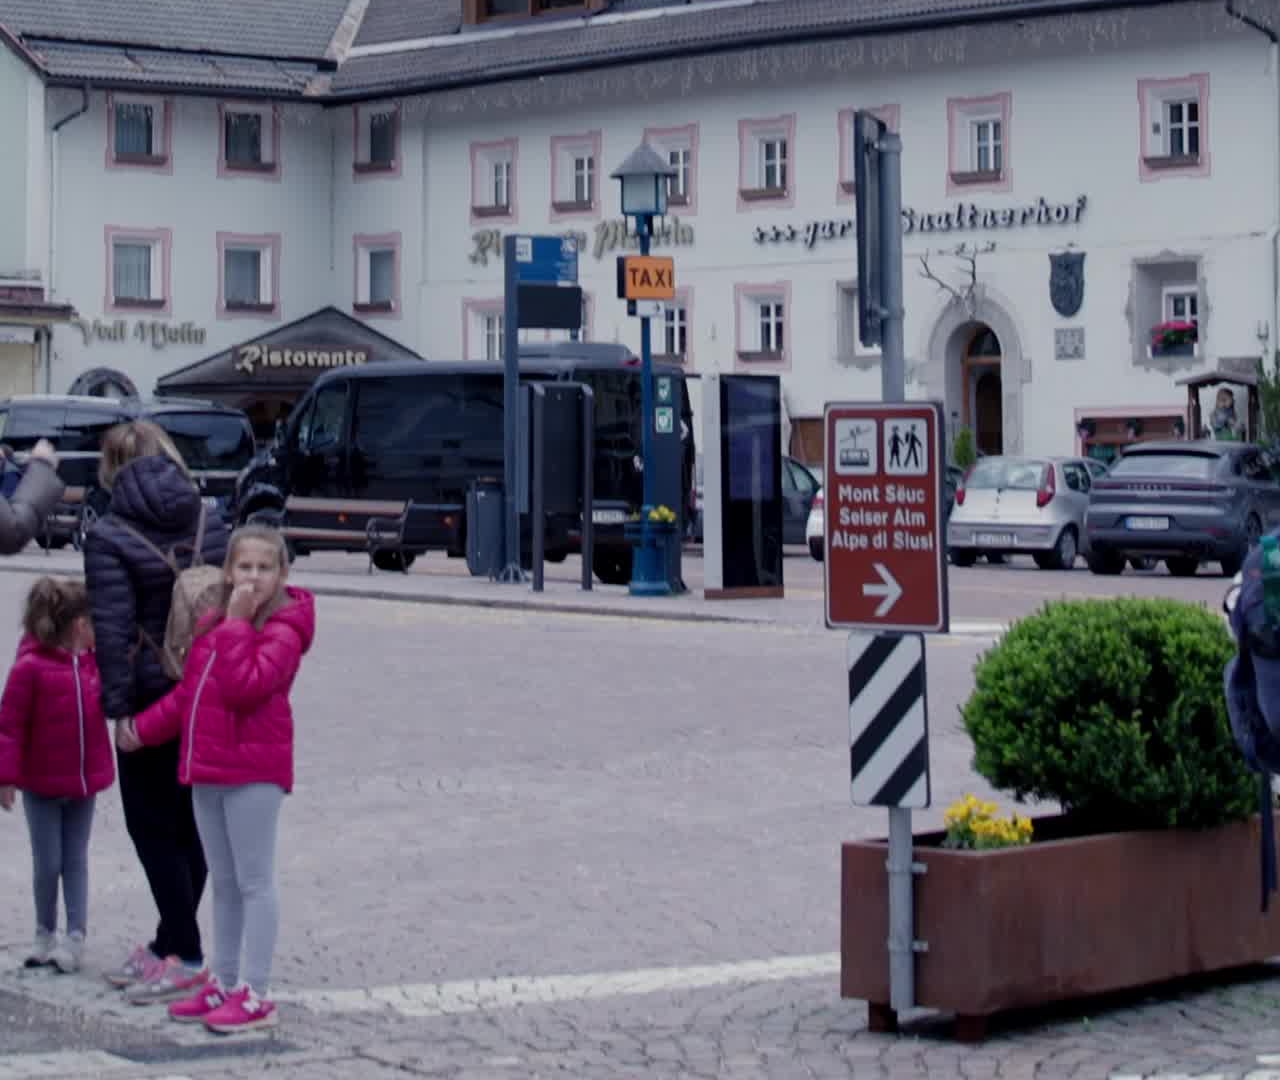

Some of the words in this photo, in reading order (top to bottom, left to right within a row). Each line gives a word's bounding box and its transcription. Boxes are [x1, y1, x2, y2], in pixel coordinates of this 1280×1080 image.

[628, 266, 673, 288] TAXI
[235, 343, 368, 374] Ristorante
[839, 483, 880, 503] Mont
[840, 506, 889, 527] Seiser
[893, 507, 926, 527] Alm
[831, 528, 869, 551] Alpe
[872, 529, 888, 550] di
[893, 529, 934, 551] Siusi
